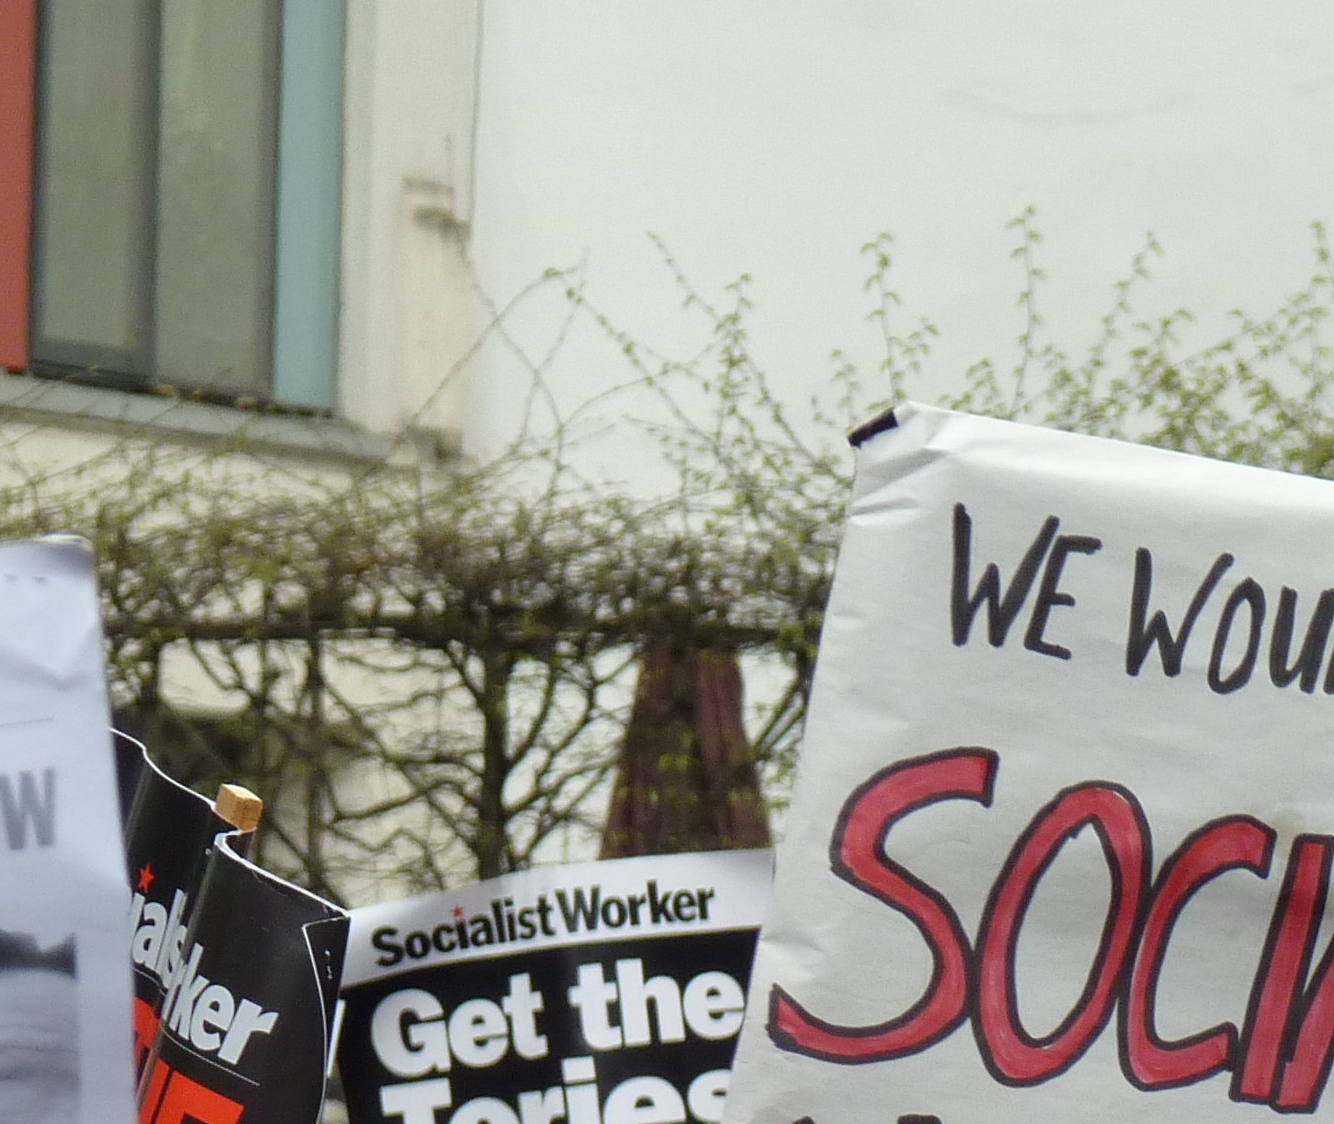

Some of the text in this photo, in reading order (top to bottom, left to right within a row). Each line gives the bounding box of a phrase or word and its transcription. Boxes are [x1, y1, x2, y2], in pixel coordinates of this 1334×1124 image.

[951, 502, 1102, 660] WE
[370, 957, 746, 1078] Get the
